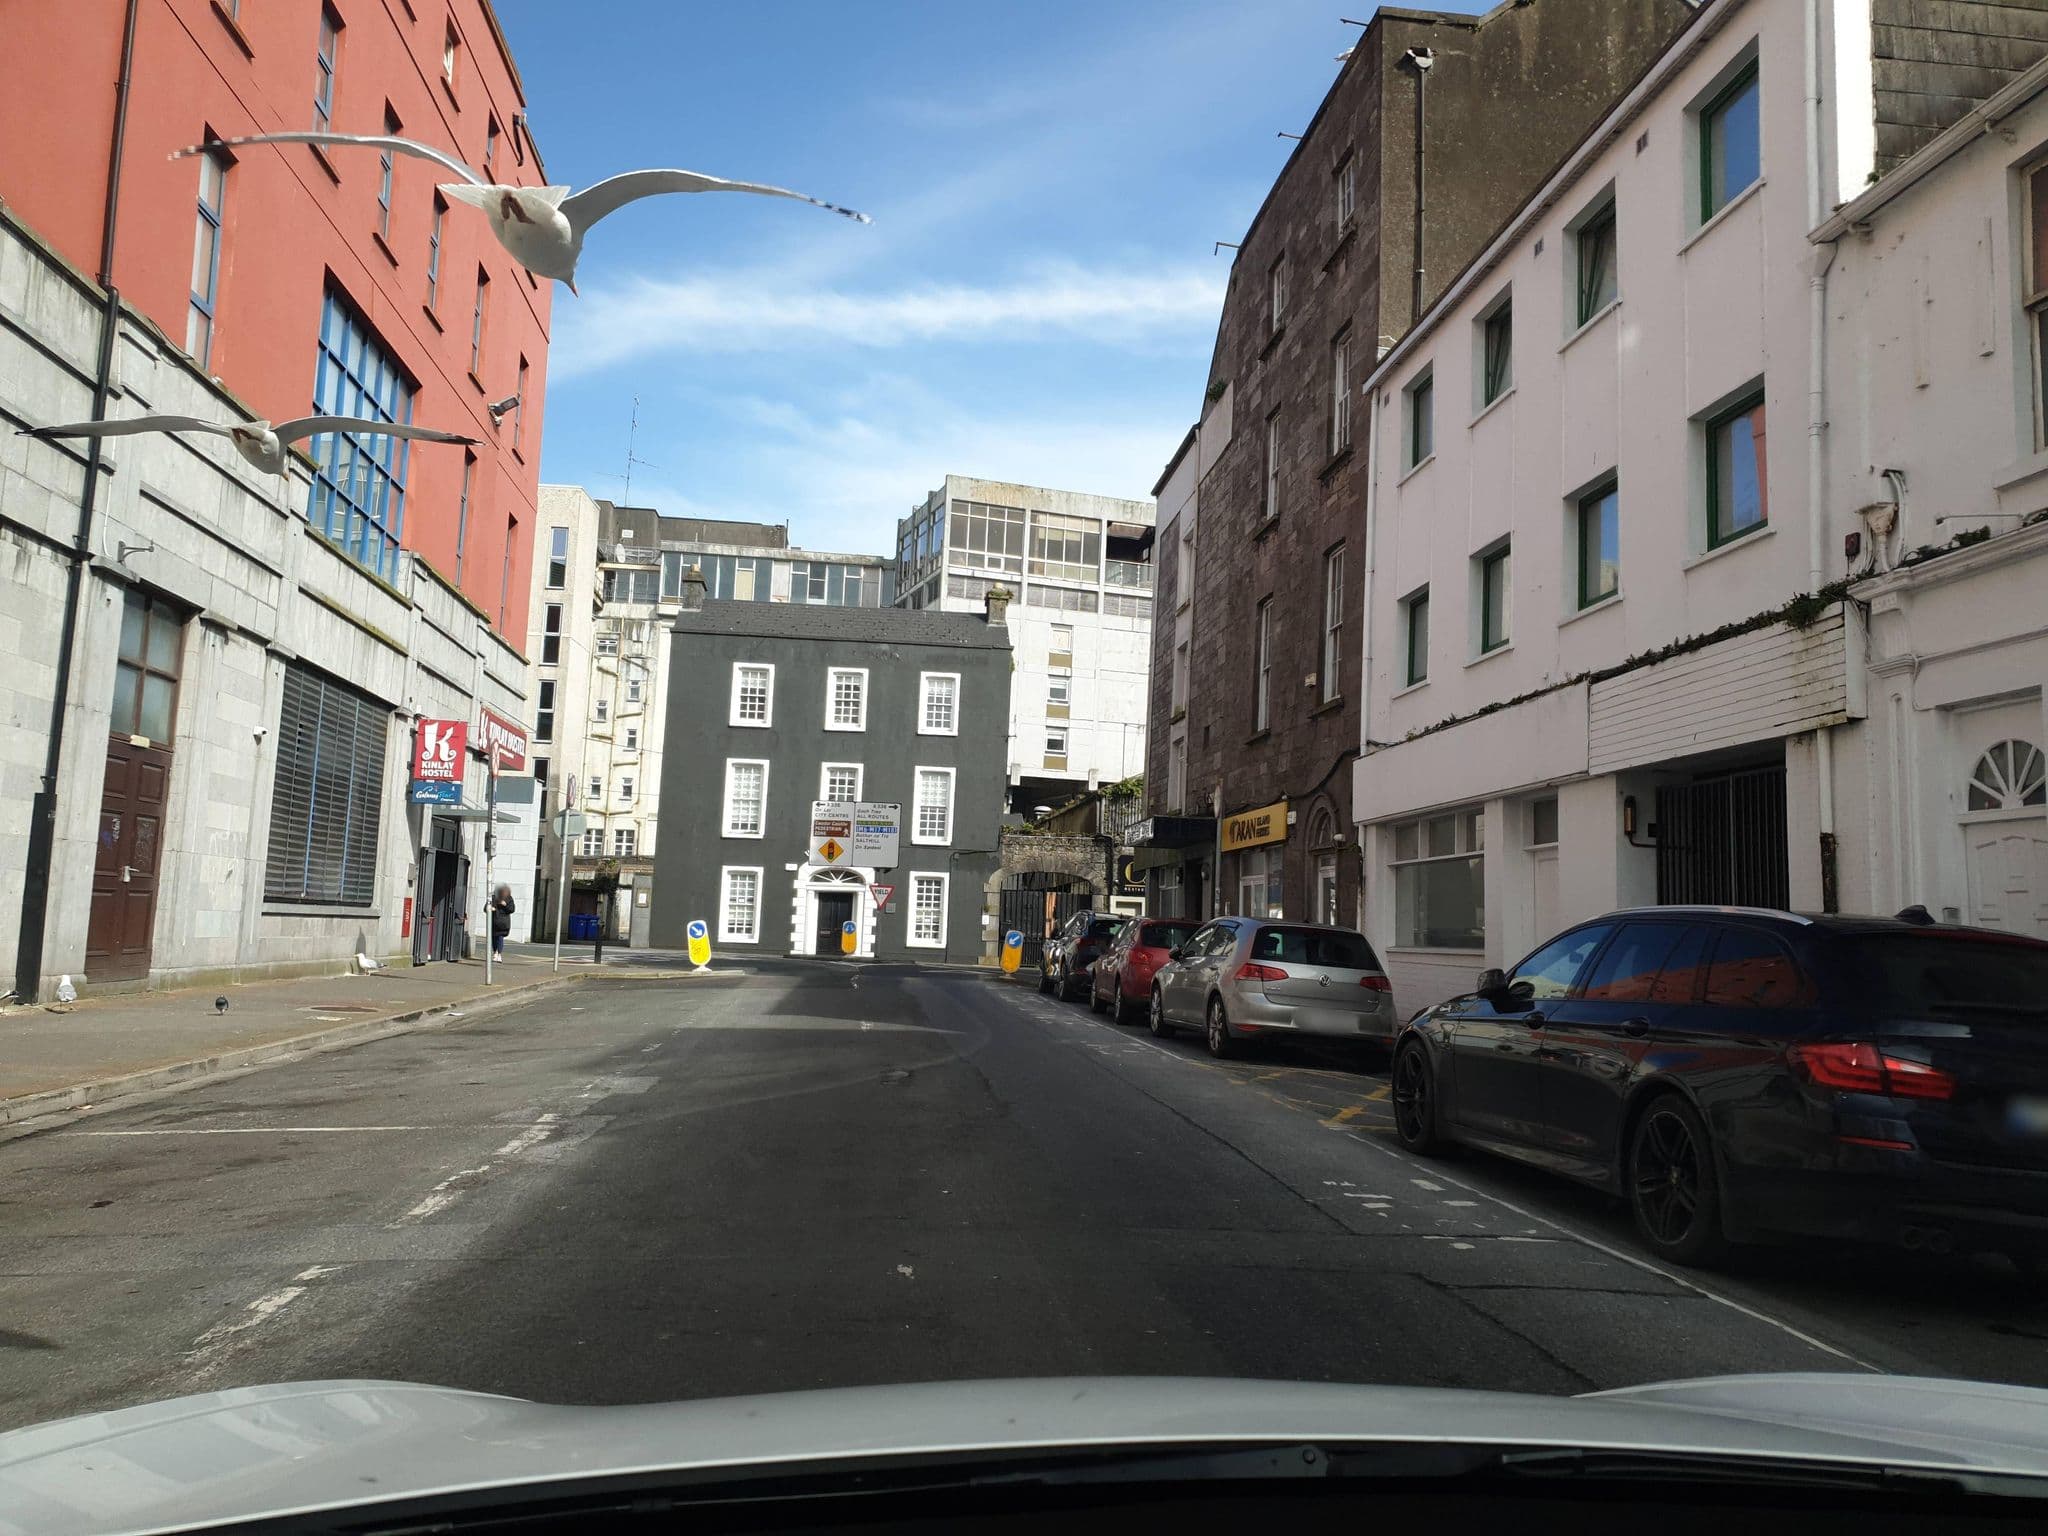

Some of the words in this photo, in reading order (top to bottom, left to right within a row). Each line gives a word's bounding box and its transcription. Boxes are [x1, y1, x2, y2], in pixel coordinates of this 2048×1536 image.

[421, 761, 455, 770] KINLAY
[421, 769, 454, 778] HOSTEL
[1236, 818, 1257, 842] ARAN
